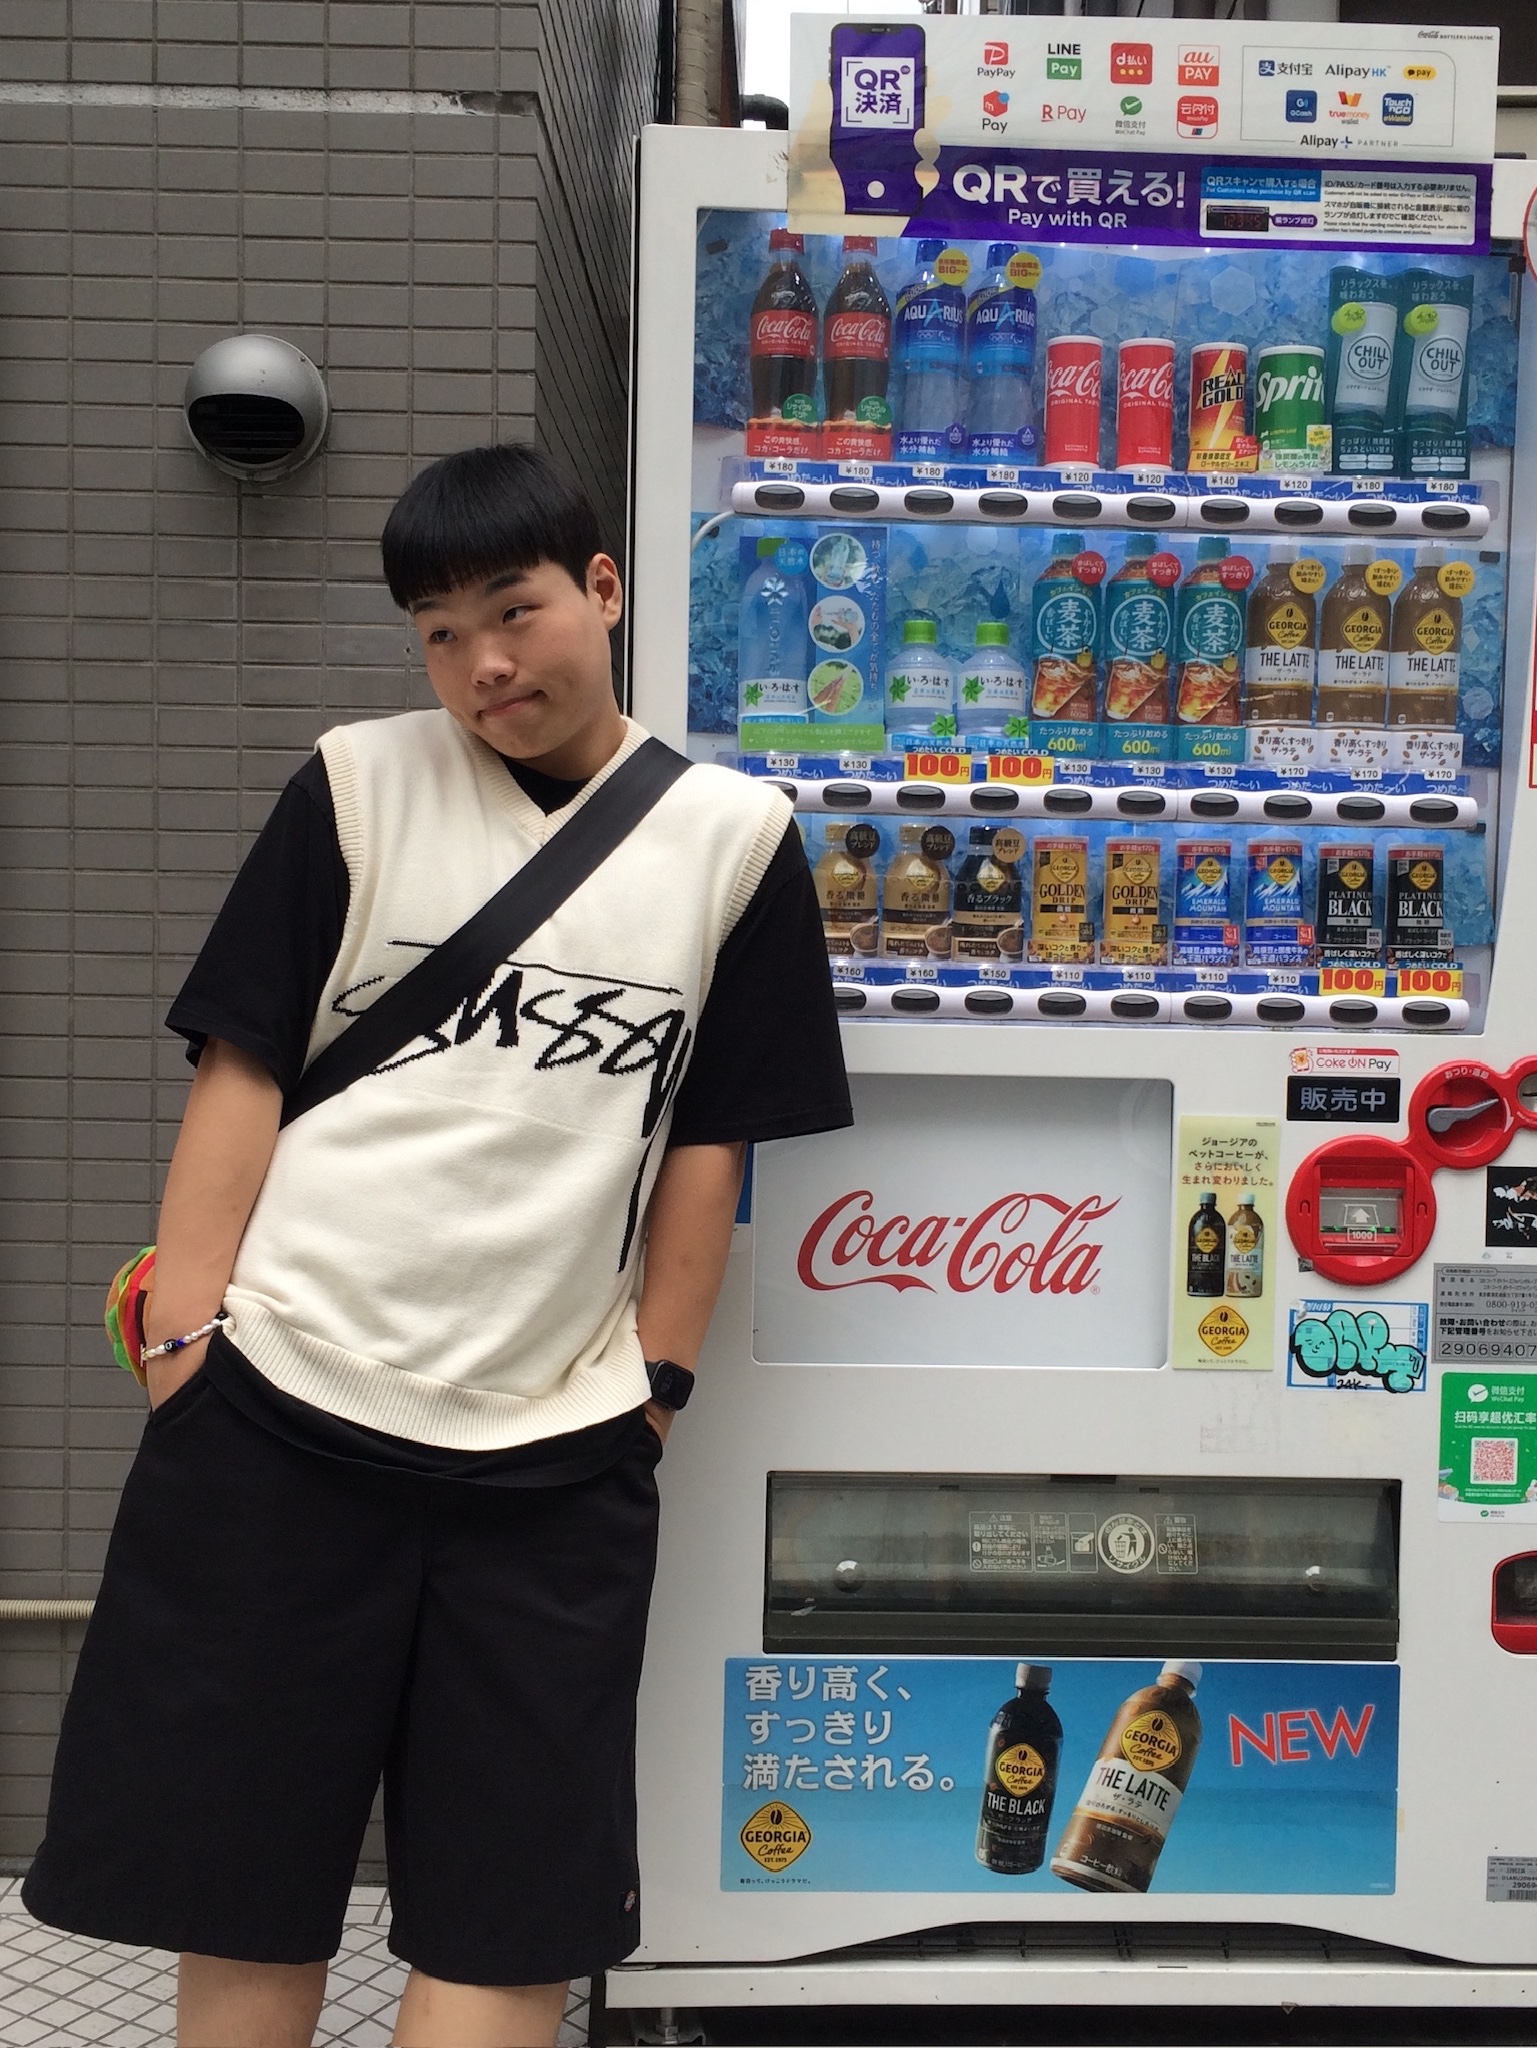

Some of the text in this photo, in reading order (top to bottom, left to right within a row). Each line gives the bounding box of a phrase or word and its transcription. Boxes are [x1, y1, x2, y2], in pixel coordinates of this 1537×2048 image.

[1048, 44, 1081, 55] LINE
[1116, 53, 1147, 66] d払い
[1184, 51, 1214, 63] au
[977, 67, 1015, 78] PayPay
[1051, 62, 1078, 77] Pay
[1185, 68, 1212, 80] PAY
[1277, 63, 1312, 75] 支付宝
[1416, 68, 1431, 77] pay
[855, 69, 900, 91] QR
[855, 92, 901, 115] 決済
[1384, 97, 1412, 106] Touch
[1058, 105, 1086, 122] Pay
[1181, 103, 1215, 114] 云闪付
[982, 118, 1007, 133] Pay
[1115, 120, 1146, 129] 微信支付
[1300, 135, 1338, 148] Alipay
[1009, 209, 1127, 229] Pay with QR
[904, 298, 963, 328] AQUARIUS
[976, 302, 1036, 331] AQUARIUS
[757, 315, 812, 340] Coca-Cola
[830, 318, 885, 342] Coca-Cola
[1355, 345, 1388, 361] CHILL
[1427, 348, 1461, 363] CHILL
[1358, 357, 1384, 370] OUT
[1431, 360, 1456, 372] OUT
[1203, 365, 1245, 390] REAL
[1202, 386, 1243, 409] GOLD
[900, 446, 936, 456] 水分補給
[972, 448, 1008, 457] 水分補給
[769, 462, 794, 472] ¥180
[846, 466, 870, 476] ¥180
[916, 466, 941, 476] ¥180
[990, 470, 1015, 480] ¥180
[1065, 473, 1089, 482] ¥120
[1137, 475, 1162, 484] ¥120
[1211, 476, 1235, 486] ¥140
[1356, 482, 1380, 490] ¥180
[1430, 483, 1454, 491] ¥180
[1057, 599, 1084, 648] 麦茶
[1131, 601, 1158, 650] 麦茶
[1202, 604, 1229, 653] 麦茶
[1269, 621, 1308, 631] GEORGIA
[1344, 625, 1382, 635] GEORGIA
[1417, 628, 1455, 637] GEORGIA
[1260, 652, 1310, 668] THE LATTE
[1336, 656, 1384, 671] THE LATTE
[1407, 658, 1456, 673] THE LATTE
[1039, 726, 1094, 737] たっぷり飲める
[1113, 729, 1168, 739] たっぷり飲める
[1184, 731, 1239, 741] たっぷり飲める
[1048, 738, 1087, 752] 600ml
[1258, 736, 1312, 746] 香り高く、すっきり
[1334, 738, 1387, 749] 香り高く、すっきり
[1406, 741, 1459, 751] 香り高く、すっきり
[1021, 748, 1049, 756] COLD
[1122, 740, 1160, 754] 600ml
[1192, 742, 1232, 756] 600ml
[770, 758, 794, 767] ¥130
[843, 761, 867, 769] ¥130
[907, 754, 969, 777] 100円
[990, 757, 1053, 779] 100円
[1064, 763, 1088, 772] ¥130
[1137, 766, 1161, 775] ¥130
[1208, 767, 1232, 775] ¥130
[1281, 767, 1304, 776] ¥170
[1354, 770, 1378, 778] ¥170
[1428, 771, 1452, 779] ¥170
[996, 838, 1020, 847] 高級豆
[1040, 884, 1086, 898] GOLDEN
[1112, 885, 1158, 899] GOLDEN
[1329, 891, 1372, 899] PLATINUM
[1399, 892, 1443, 900] PLATINUM
[967, 894, 1012, 904] 香るブラック
[1328, 899, 1372, 916] BLACK
[1399, 901, 1443, 917] BLACK
[837, 968, 861, 976] ¥160
[910, 969, 934, 977] ¥160
[982, 970, 1007, 978] ¥150
[1056, 971, 1079, 980] ¥110
[1200, 973, 1224, 981] ¥110
[1322, 969, 1383, 991] 100円
[1400, 970, 1461, 992] 100円
[1317, 1057, 1391, 1071] Coke ON Pay
[1300, 1087, 1386, 1112] 販売中
[1202, 1137, 1257, 1147] ジョージアの
[1189, 1150, 1269, 1161] ペットコーヒーが、
[1194, 1163, 1261, 1171] さらにおいしく
[1182, 1176, 1274, 1186] 生まれ変わりました。
[1352, 1231, 1373, 1240] 1000
[797, 1190, 1123, 1294] Coca-Cola
[1231, 1254, 1259, 1263] THE LATTE
[1202, 1326, 1246, 1335] GEORGIA
[1211, 1336, 1236, 1345] Coffee
[1441, 1343, 1537, 1356] 29069407
[1491, 1386, 1525, 1396] 微信支付
[1455, 1411, 1537, 1424] 扫码享超优汇率
[746, 1665, 912, 1702] 香り高く、
[745, 1710, 892, 1745] すっきり
[1229, 1703, 1375, 1767] NEW
[1124, 1729, 1178, 1757] GEORGIA
[1129, 1743, 1164, 1760] Coffee
[742, 1753, 955, 1792] 満たされる。
[999, 1762, 1044, 1777] GEORGIA
[1007, 1774, 1033, 1785] Coffee
[1096, 1766, 1171, 1812] THE LATTE
[987, 1792, 1046, 1816] THE BLACK
[746, 1830, 806, 1843] GEORGIA
[758, 1844, 794, 1856] Coffee
